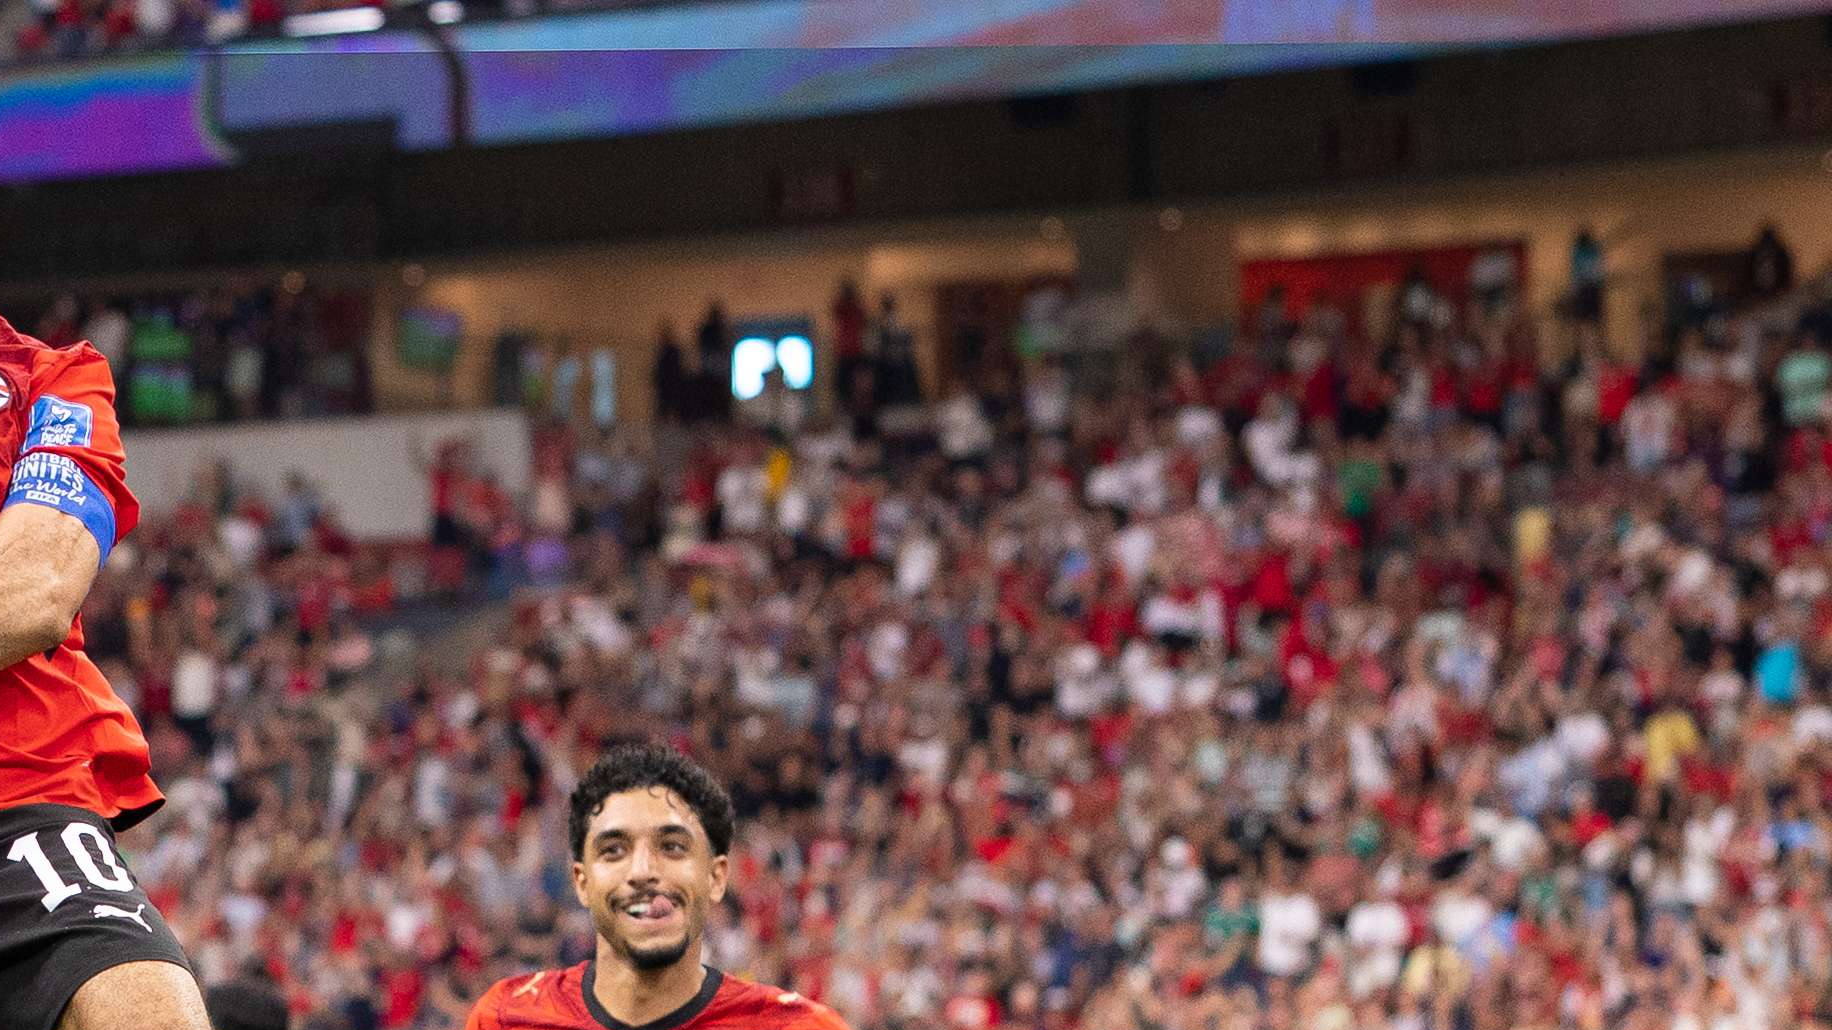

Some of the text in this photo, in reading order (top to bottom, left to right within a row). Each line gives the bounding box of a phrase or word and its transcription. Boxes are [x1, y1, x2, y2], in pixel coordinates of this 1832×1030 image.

[41, 433, 74, 446] PEACE
[12, 461, 84, 492] UNITES
[36, 479, 87, 506] World
[6, 822, 134, 913] 10
